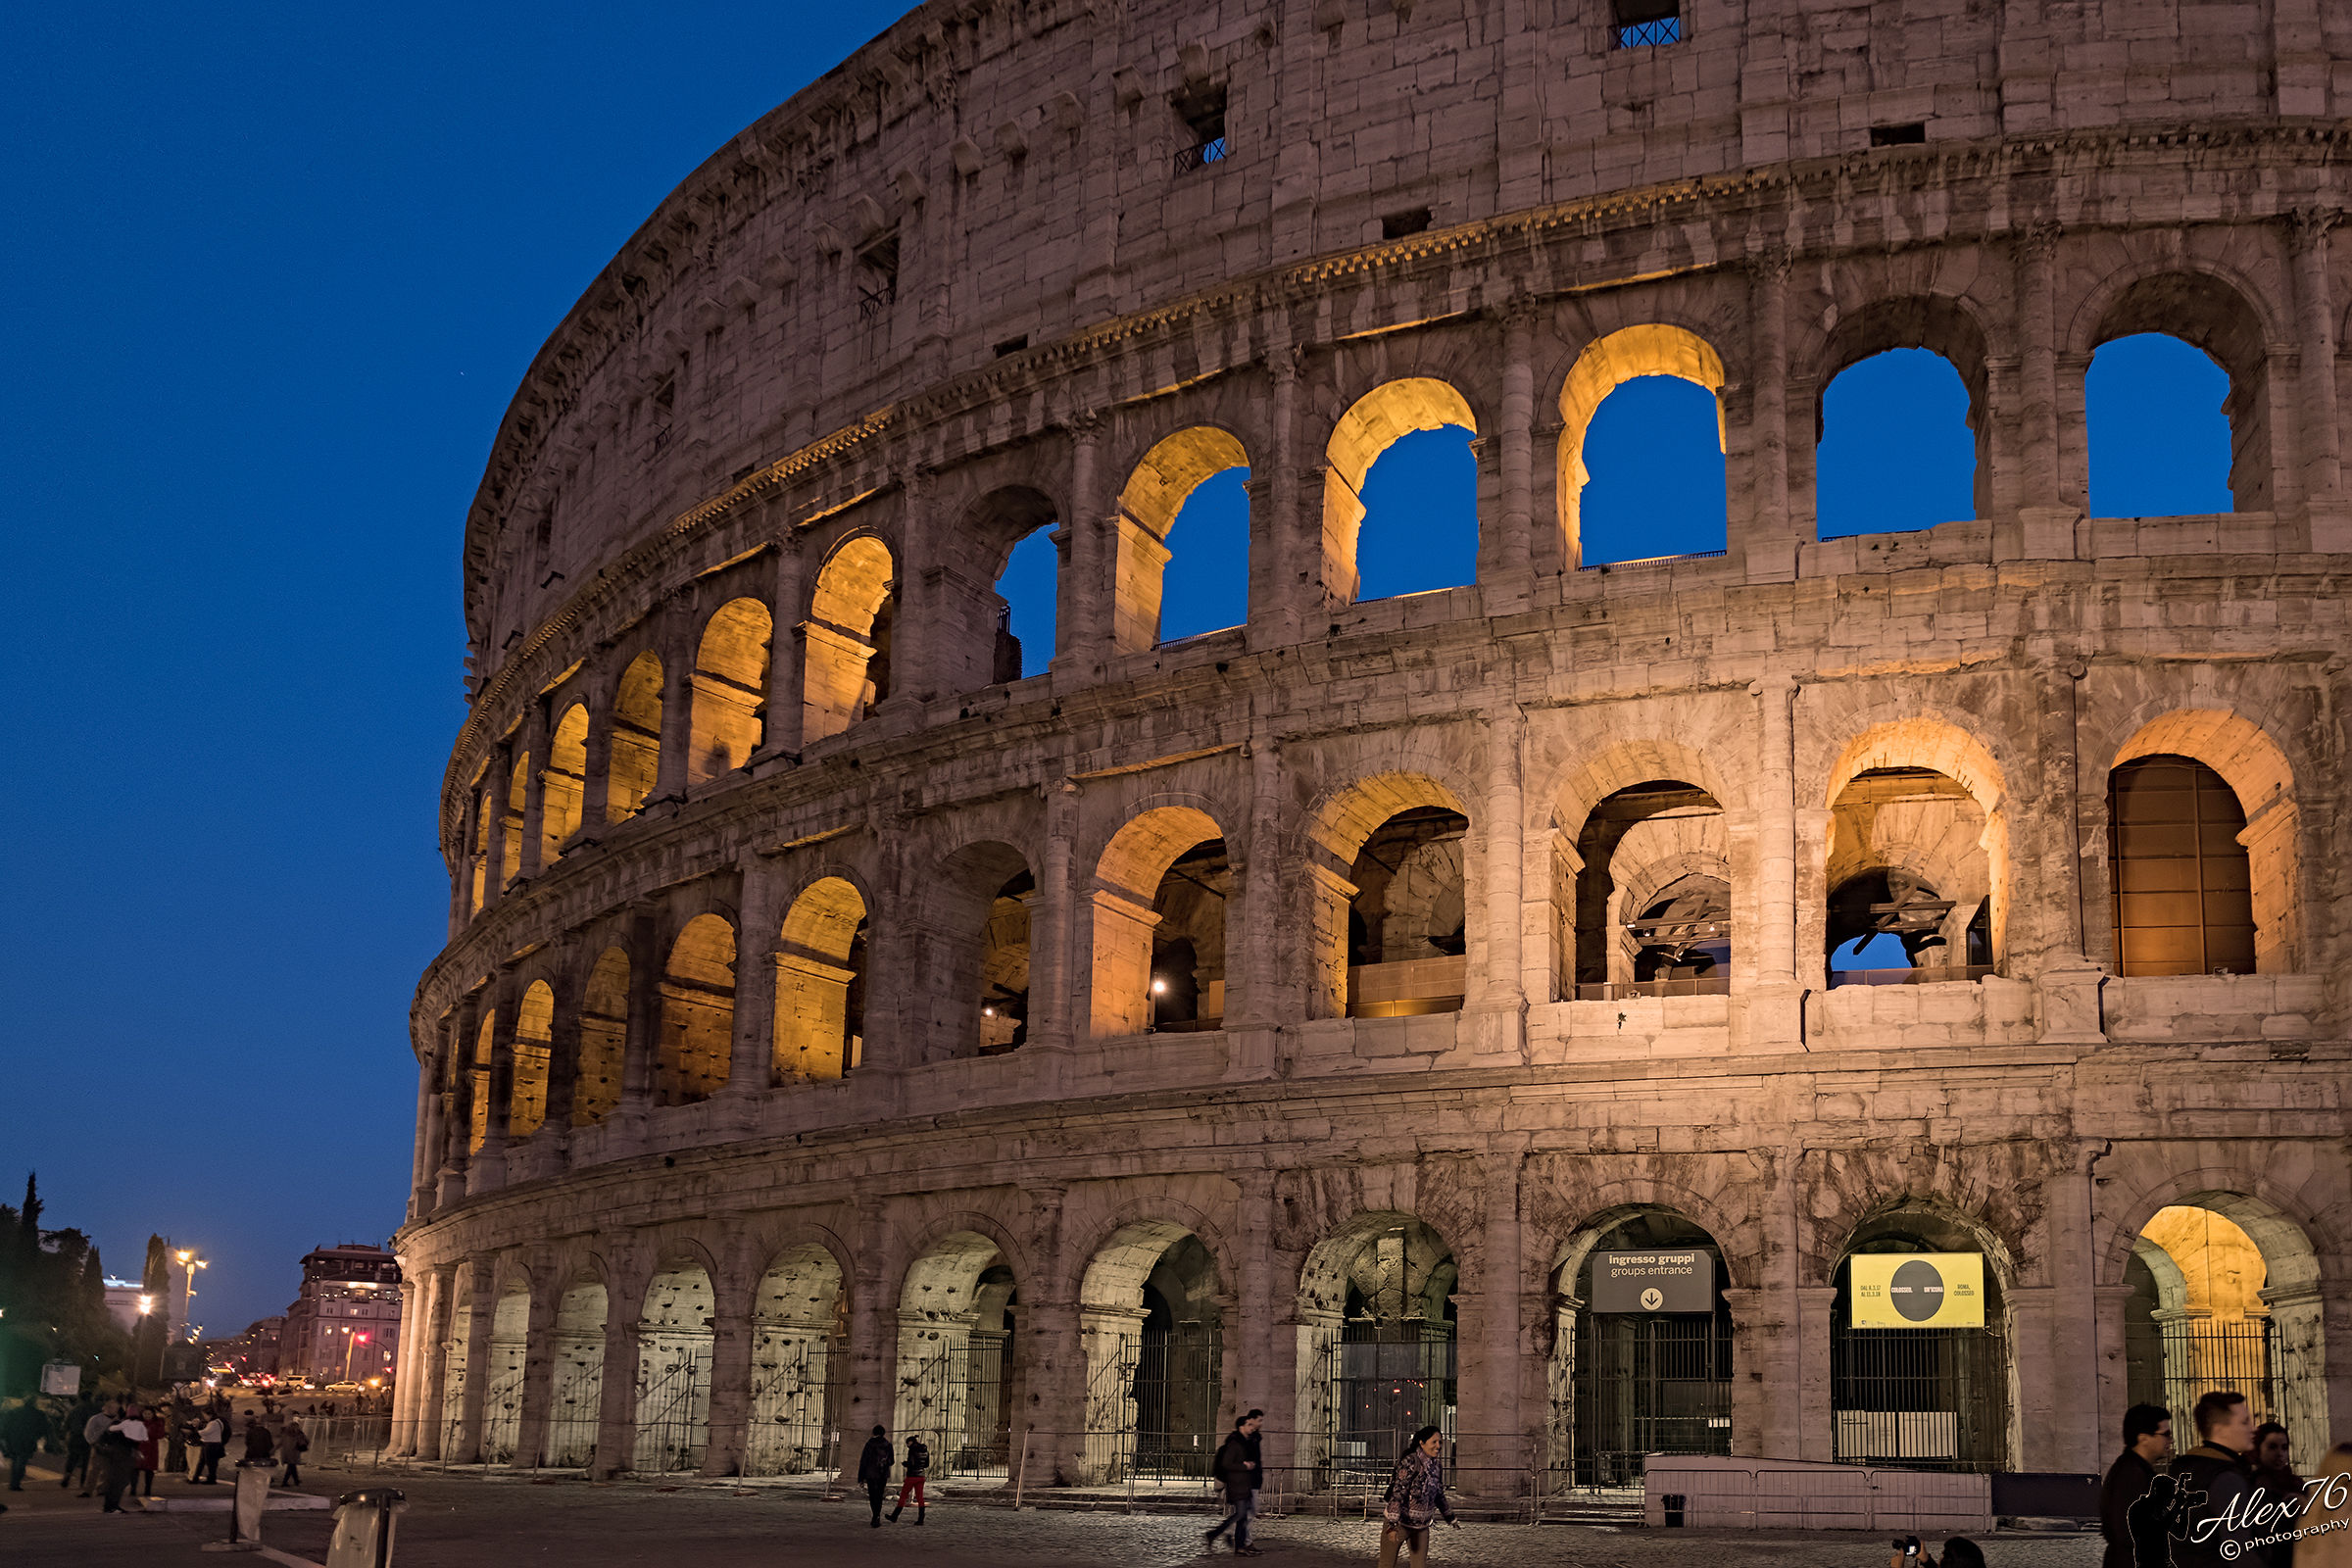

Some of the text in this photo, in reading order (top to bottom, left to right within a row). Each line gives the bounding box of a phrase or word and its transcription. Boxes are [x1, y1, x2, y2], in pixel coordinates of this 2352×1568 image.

[1608, 1252, 1695, 1266] ingresso gruppi
[1610, 1265, 1693, 1278] groups entrance
